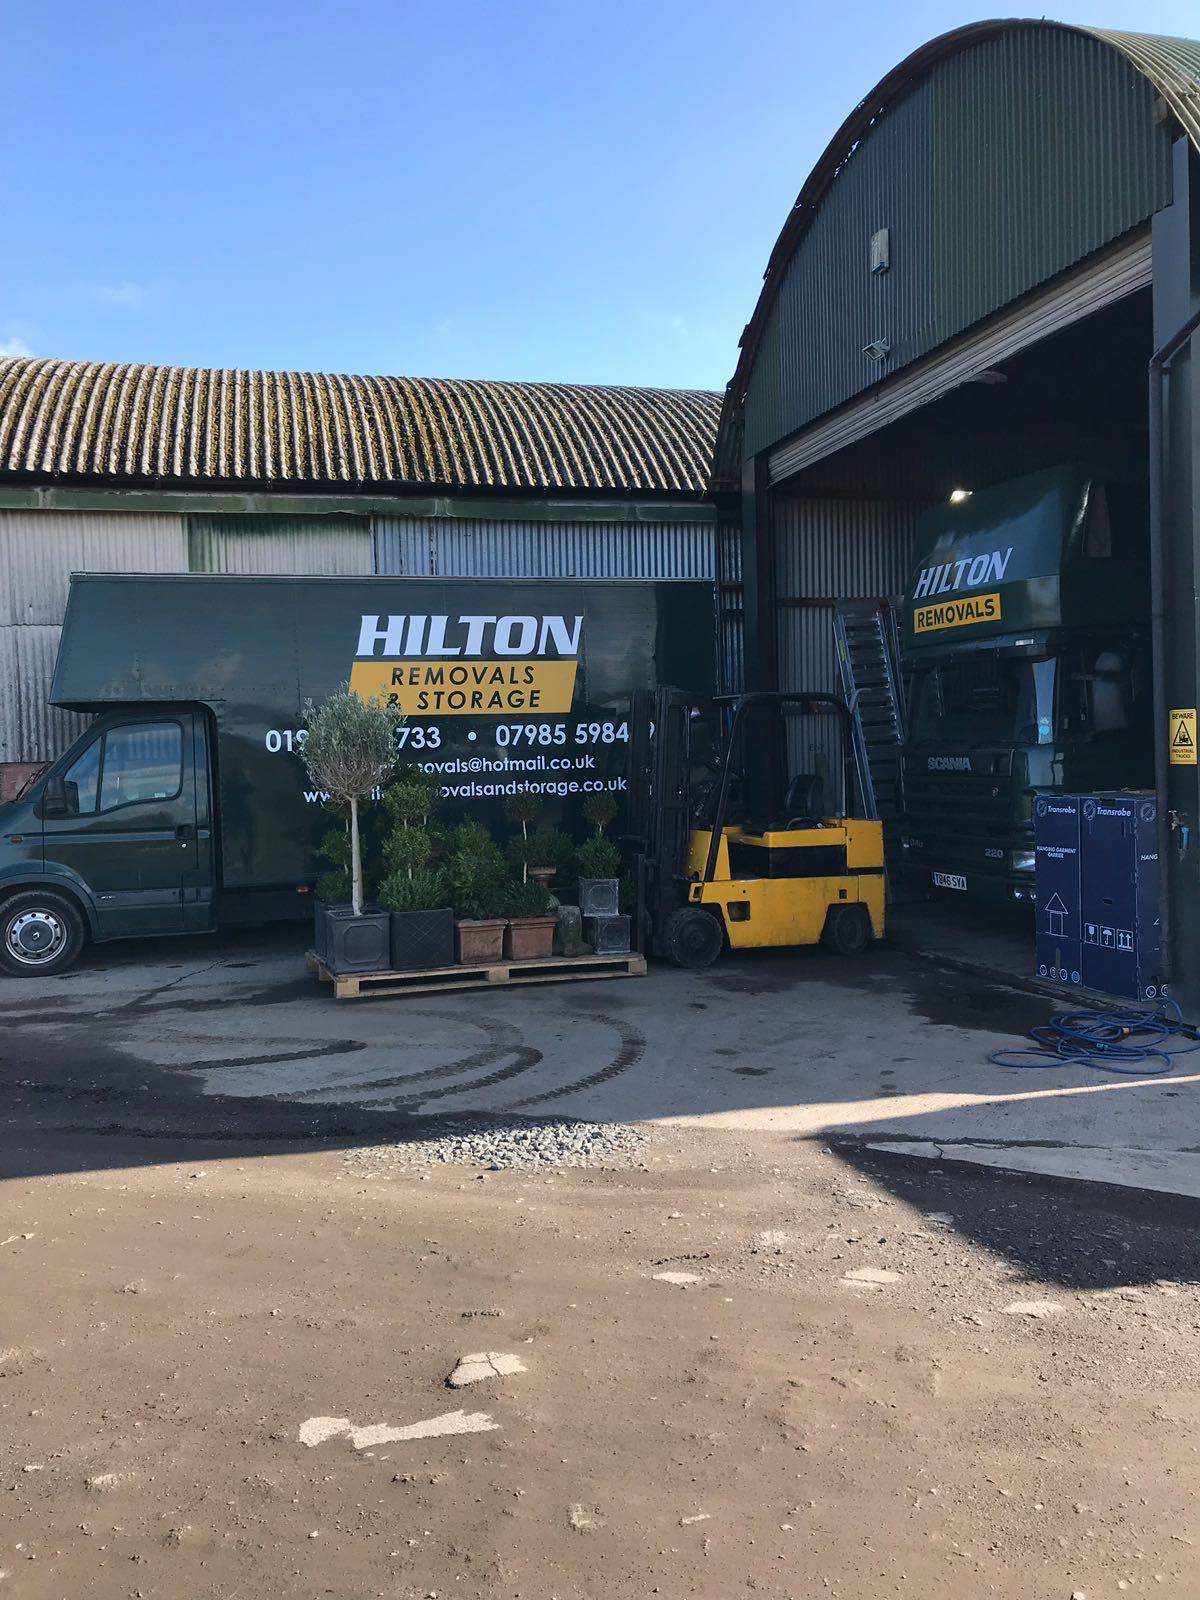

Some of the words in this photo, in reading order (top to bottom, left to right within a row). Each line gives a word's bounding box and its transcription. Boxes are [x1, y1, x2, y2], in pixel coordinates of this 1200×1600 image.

[913, 547, 1013, 599] HILTON
[917, 598, 995, 629] REMOVALS
[355, 614, 584, 656] HILTON
[391, 666, 535, 686] REMOVALS
[388, 692, 401, 710] &
[417, 690, 541, 710] STORAGE
[495, 724, 567, 746] 07985
[419, 755, 596, 775] ovals@hotmail.co.uk
[927, 757, 972, 771] SCANIA
[1047, 805, 1076, 814] Transrobe
[1097, 807, 1132, 817] Transrobe
[984, 848, 1004, 859] 220
[1140, 853, 1158, 861] HANG
[952, 876, 966, 889] SYA
